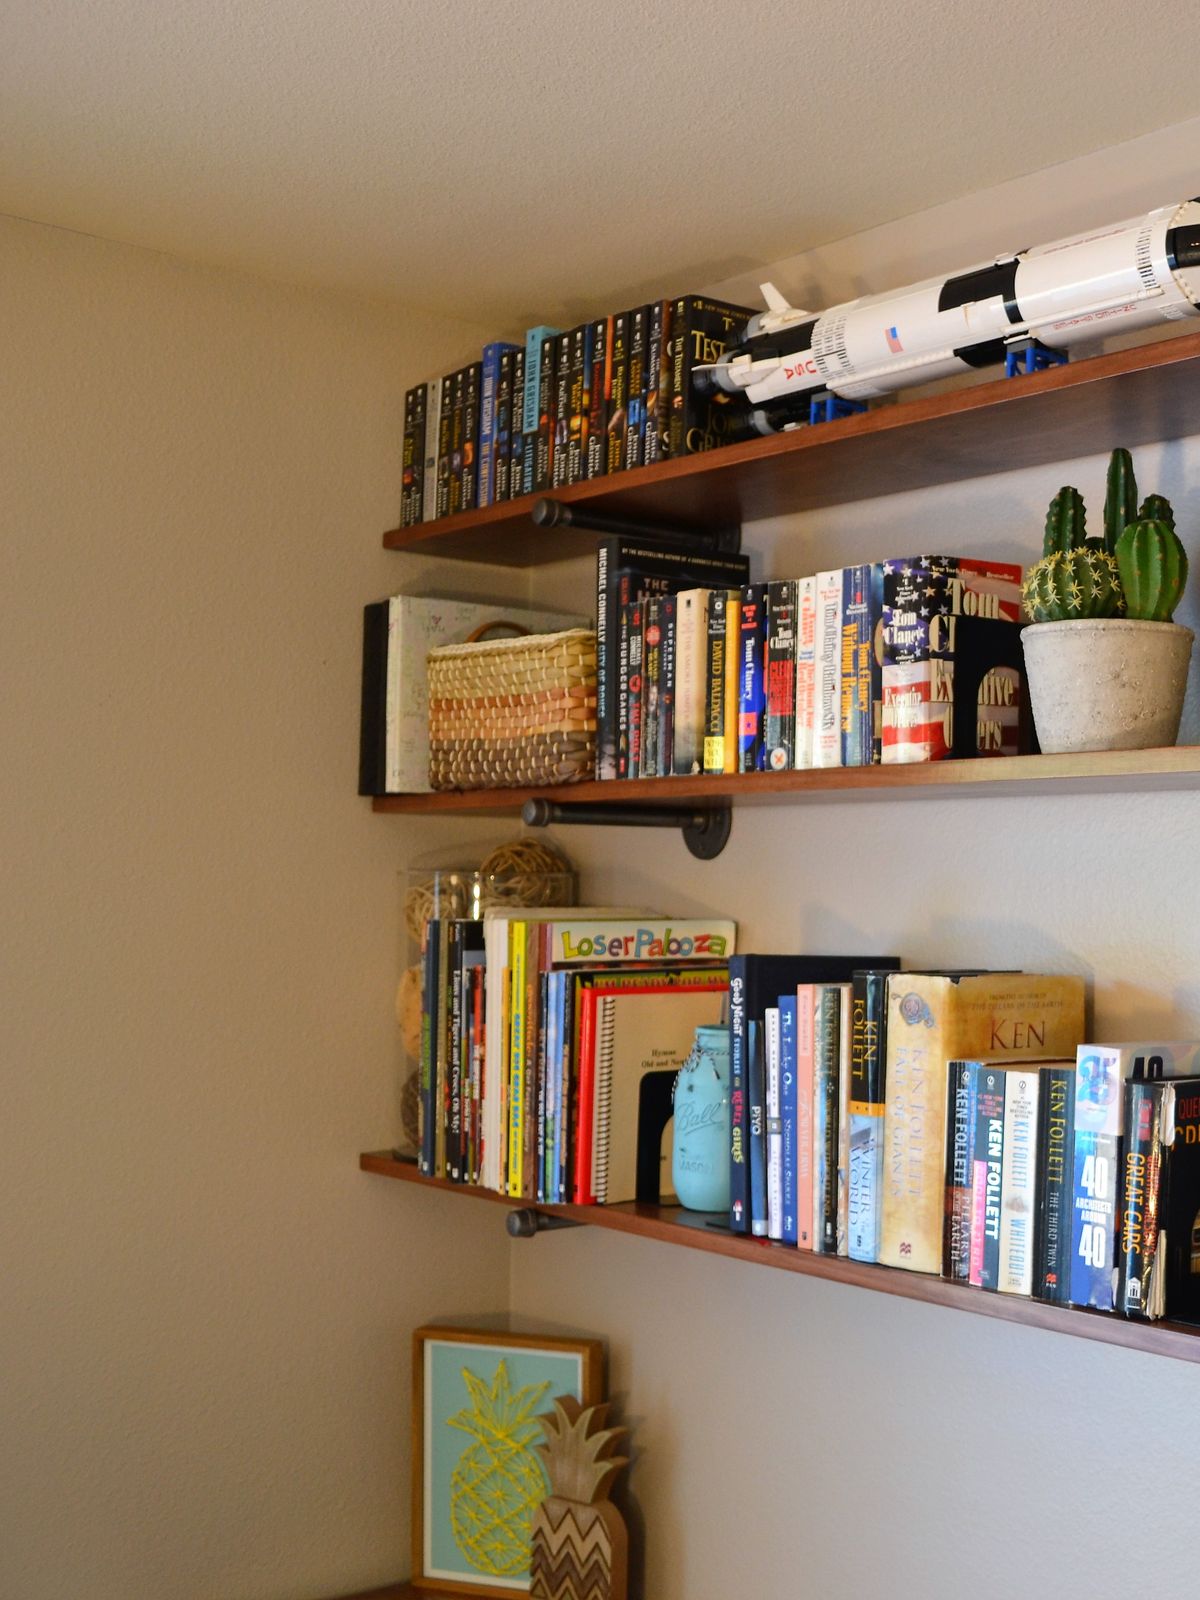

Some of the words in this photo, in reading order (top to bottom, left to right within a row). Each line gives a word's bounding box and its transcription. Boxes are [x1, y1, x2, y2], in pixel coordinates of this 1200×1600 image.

[528, 359, 536, 382] JOHN
[674, 354, 684, 392] TESTAMENT
[784, 360, 816, 379] USA
[482, 398, 492, 435] GRISHAM
[526, 385, 536, 429] GRISHAM
[598, 548, 608, 592] MICHAEL
[643, 577, 670, 591] THE
[893, 608, 917, 626] Tom
[947, 577, 1000, 620] Tom
[598, 593, 606, 642] CONNELLY
[778, 627, 793, 639] Tom
[598, 645, 606, 667] CITY
[711, 640, 722, 674] DAVID
[745, 637, 756, 662] Tom
[770, 636, 794, 651] Clancy
[820, 627, 837, 664] Clancy
[842, 623, 858, 674] Without
[858, 641, 870, 669] Tom
[598, 670, 606, 683] OF
[742, 663, 756, 701] Clancy
[823, 664, 836, 711] Rainbow
[855, 670, 870, 712] Clancy
[710, 678, 722, 733] BALDACCI
[841, 676, 858, 733] Remorse
[782, 1011, 792, 1033] The
[825, 992, 834, 1019] KEN
[452, 1017, 460, 1046] Tigers
[824, 1023, 834, 1077] FOLLETT
[852, 1000, 864, 1080] FOLLETT
[863, 1020, 878, 1062] KEN
[990, 1018, 1046, 1050] KEN
[652, 1049, 676, 1058] Hymns
[780, 1036, 792, 1070] Lucky
[894, 1046, 907, 1086] FALL
[782, 1072, 792, 1096] One
[910, 1048, 926, 1096] KEN
[452, 1098, 460, 1112] Oh
[732, 1090, 743, 1125] REBEL
[893, 1095, 906, 1118] OF
[956, 1088, 970, 1119] KEN
[1050, 1079, 1067, 1112] KEN
[678, 1101, 722, 1131] Ball
[1013, 1121, 1029, 1142] KEN
[731, 1126, 744, 1163] GIRLS
[908, 1104, 925, 1198] FOLLETT
[954, 1123, 968, 1184] FOLLETT
[988, 1119, 1002, 1156] KEN
[1048, 1117, 1066, 1184] FOLLETT
[861, 1138, 874, 1214] WINTER
[890, 1126, 905, 1198] GIANTS
[1012, 1146, 1028, 1189] FOLLETT
[1081, 1154, 1108, 1199] 40
[1124, 1152, 1146, 1206] GREAT
[850, 1146, 860, 1226] WORLD
[984, 1161, 1001, 1240] FOLLETT
[1049, 1192, 1060, 1208] THE
[1076, 1197, 1112, 1214] ARCHITECTS
[1080, 1210, 1107, 1225] AROUND
[950, 1214, 961, 1260] EARTH
[960, 1196, 970, 1258] PILLARS
[1048, 1212, 1059, 1240] THIRD
[1122, 1210, 1142, 1255] CARS
[1009, 1219, 1026, 1278] WHITEOUT
[1046, 1244, 1058, 1266] TWIN
[1078, 1224, 1106, 1269] 40
